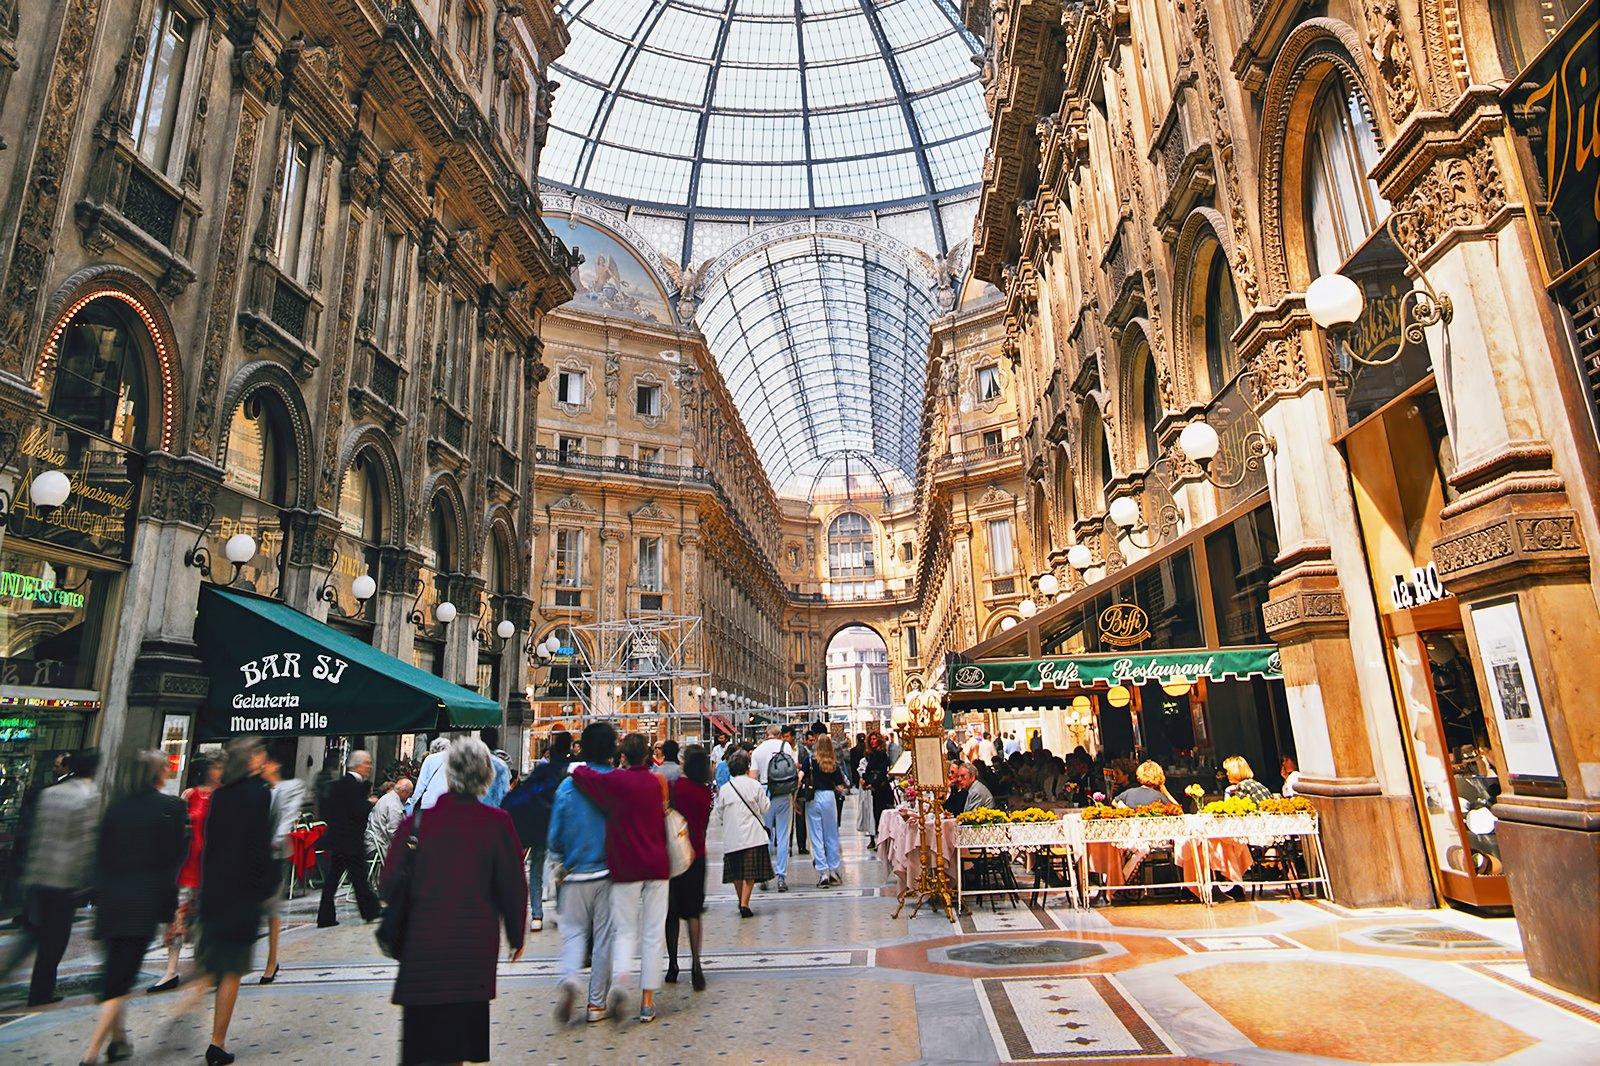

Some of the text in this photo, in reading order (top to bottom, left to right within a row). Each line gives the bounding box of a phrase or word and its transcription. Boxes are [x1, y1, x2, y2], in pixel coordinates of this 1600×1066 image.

[1524, 20, 1600, 217] Vi
[70, 471, 135, 510] ternazionale
[1106, 606, 1142, 637] Biffi
[240, 652, 301, 688] BAR
[960, 670, 981, 685] Biffi
[1037, 656, 1215, 686] Café Restaurant
[232, 692, 300, 709] Gelateria
[299, 712, 328, 730] Pils
